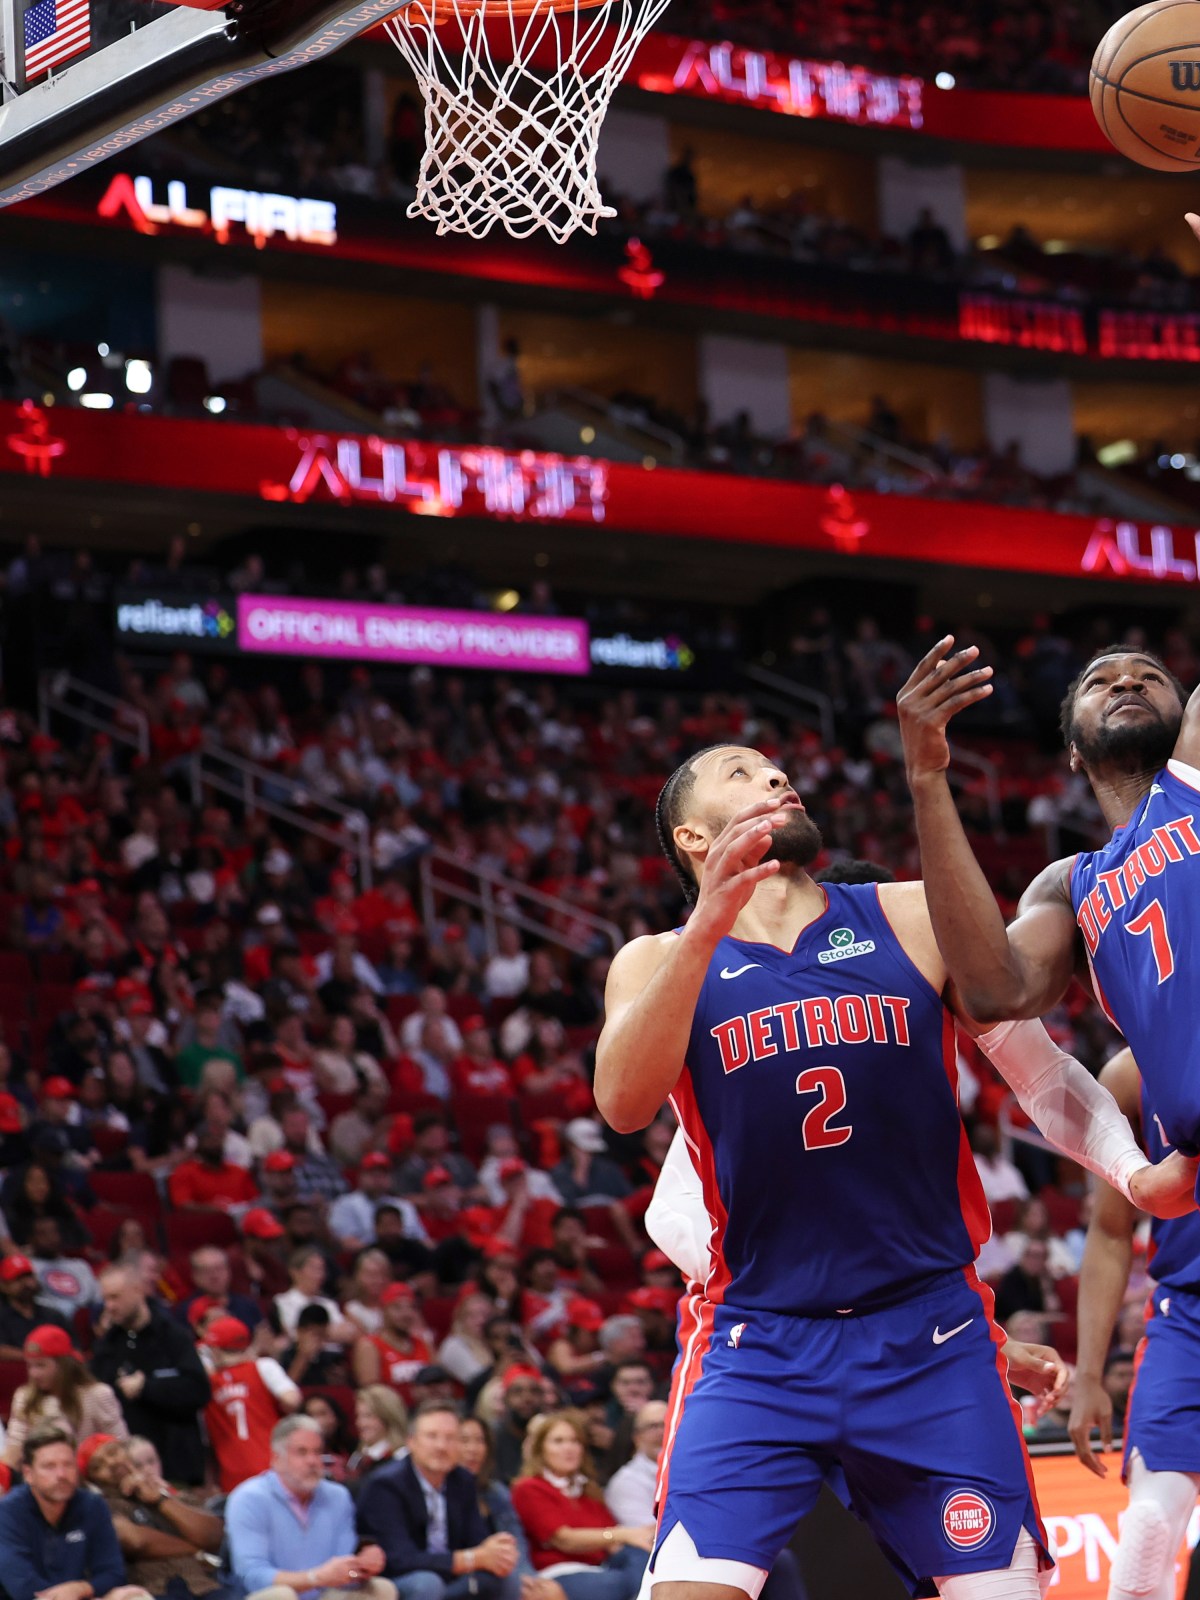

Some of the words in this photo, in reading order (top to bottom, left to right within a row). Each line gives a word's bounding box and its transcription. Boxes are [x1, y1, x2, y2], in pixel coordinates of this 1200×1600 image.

[76, 102, 196, 162] veraclinic.net
[199, 77, 242, 97] Hair
[236, 29, 346, 79] Transplant
[97, 173, 207, 236] ALL
[209, 186, 337, 249] FIRE
[117, 599, 206, 637] reliant
[247, 607, 365, 647] OFFICIAL
[363, 616, 459, 654] ENERGY
[459, 622, 580, 662] PROVIDER
[590, 632, 670, 670] reliant
[1124, 897, 1174, 985] 7
[710, 994, 911, 1075] DETROIT
[795, 1065, 853, 1151] 2
[948, 1508, 983, 1521] DETROIT
[949, 1519, 984, 1531] PISTONS
